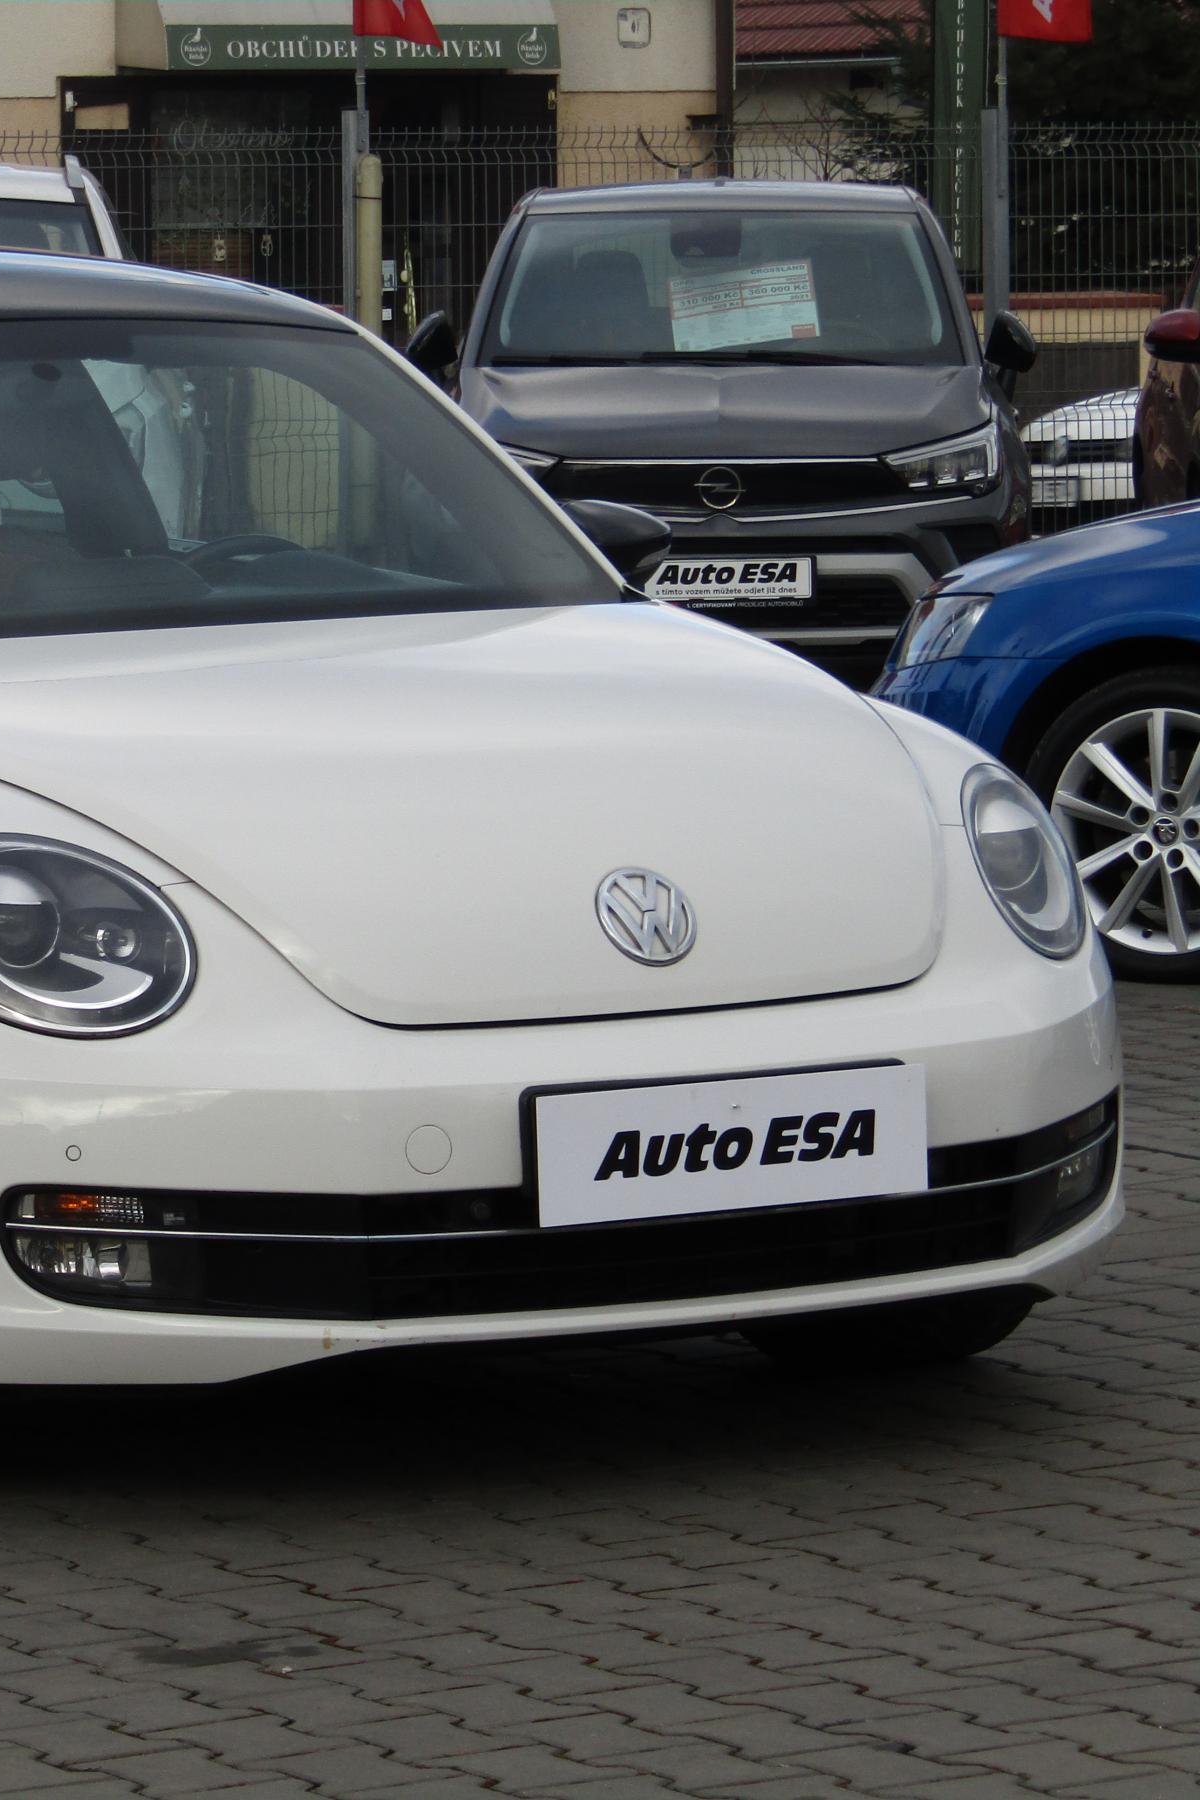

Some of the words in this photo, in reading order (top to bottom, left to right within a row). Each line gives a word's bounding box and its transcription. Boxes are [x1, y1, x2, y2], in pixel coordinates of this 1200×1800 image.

[373, 40, 386, 58] S
[770, 285, 791, 294] 000
[656, 563, 735, 586] Auto
[738, 562, 798, 584] ESA
[685, 588, 711, 596] vozem
[713, 586, 742, 595] můžete
[744, 586, 765, 596] odjet
[778, 586, 797, 594] dnes
[594, 1123, 753, 1181] Auto
[759, 1108, 876, 1166] ESA
